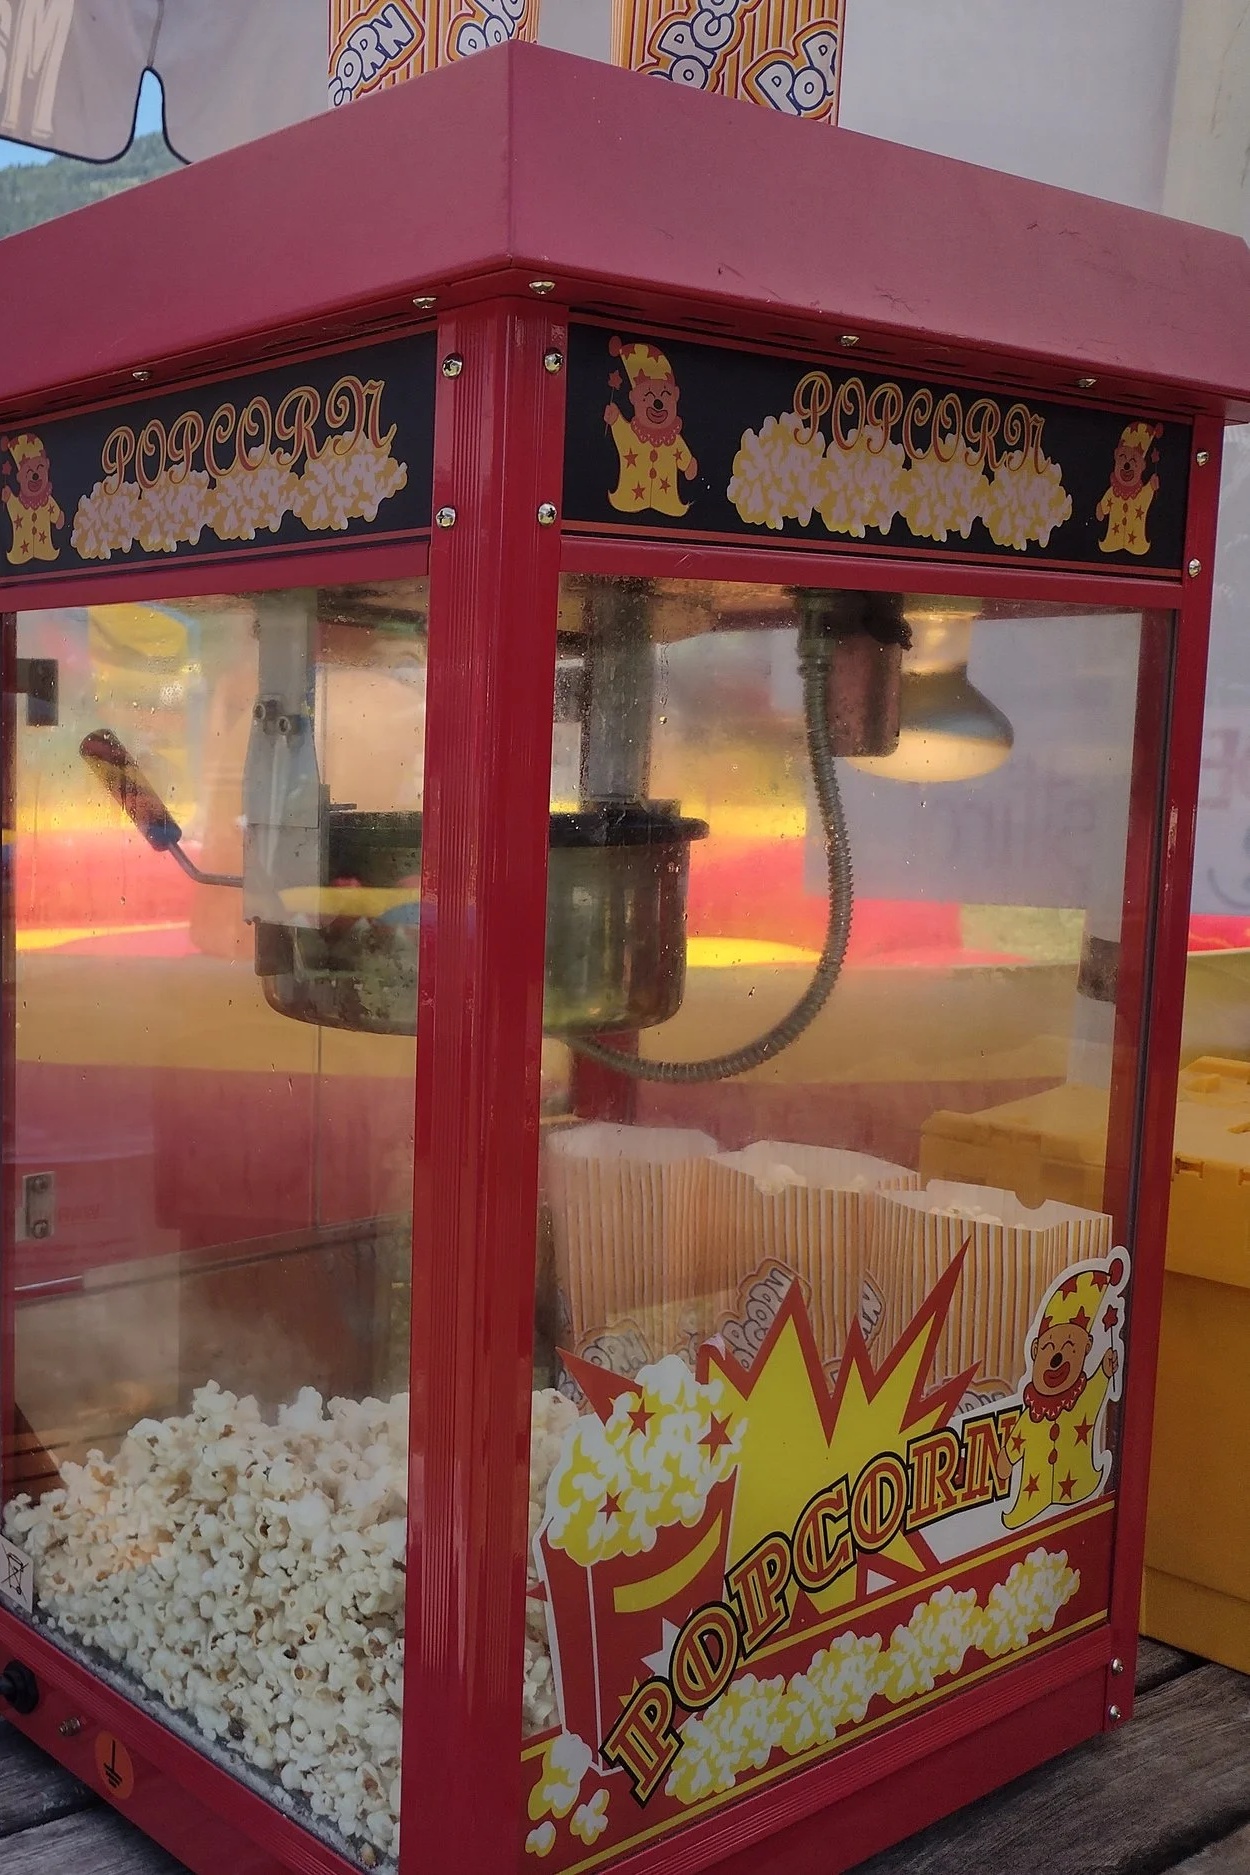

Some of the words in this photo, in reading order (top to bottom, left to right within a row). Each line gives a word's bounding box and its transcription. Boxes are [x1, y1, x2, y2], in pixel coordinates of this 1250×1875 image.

[101, 375, 398, 496] POPCORN
[793, 370, 1052, 475] POPCORN
[600, 1405, 1024, 1808] POPCORN
